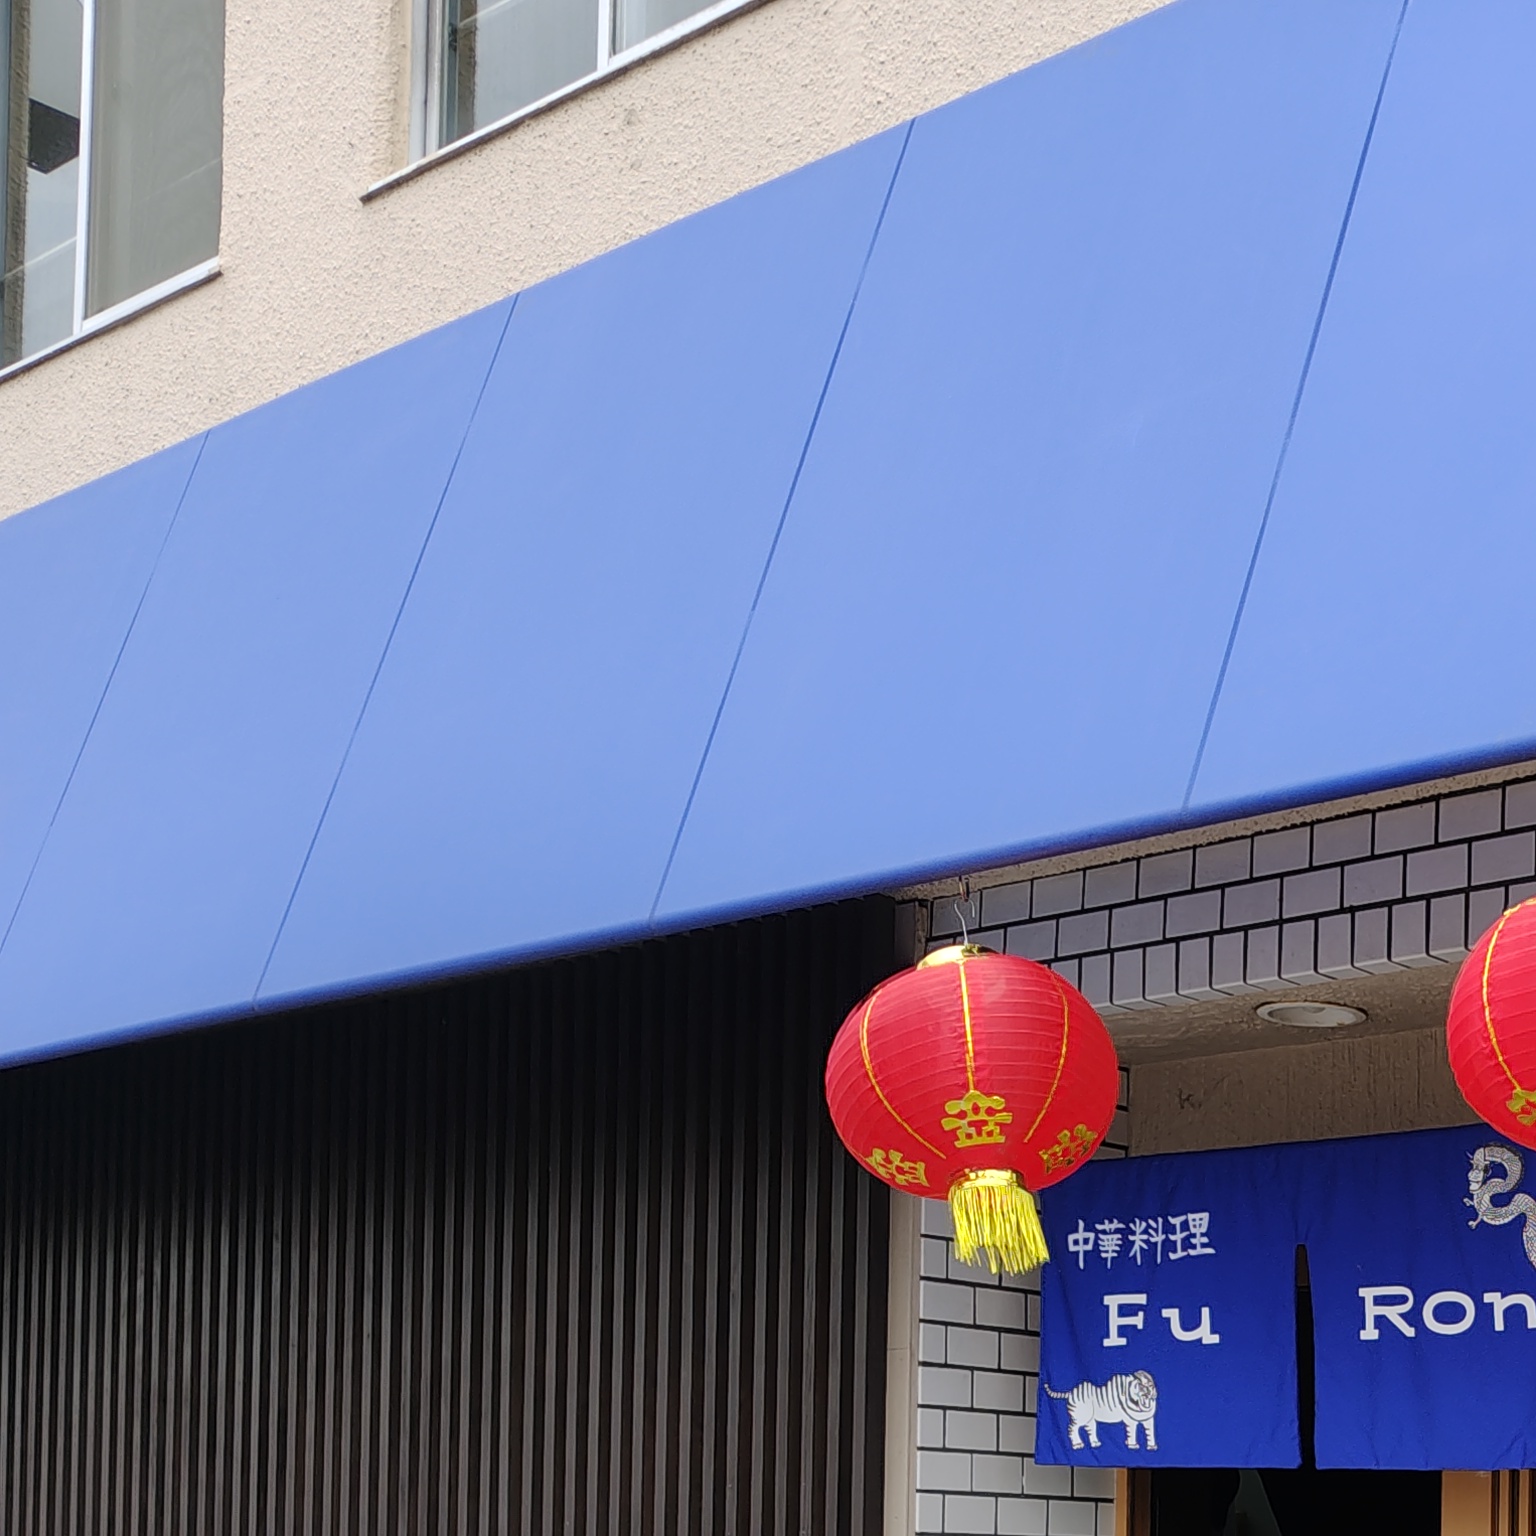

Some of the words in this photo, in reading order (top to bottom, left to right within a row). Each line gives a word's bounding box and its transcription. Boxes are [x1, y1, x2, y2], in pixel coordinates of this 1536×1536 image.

[1067, 1211, 1217, 1270] 中華料理
[1103, 1293, 1220, 1347] Fu
